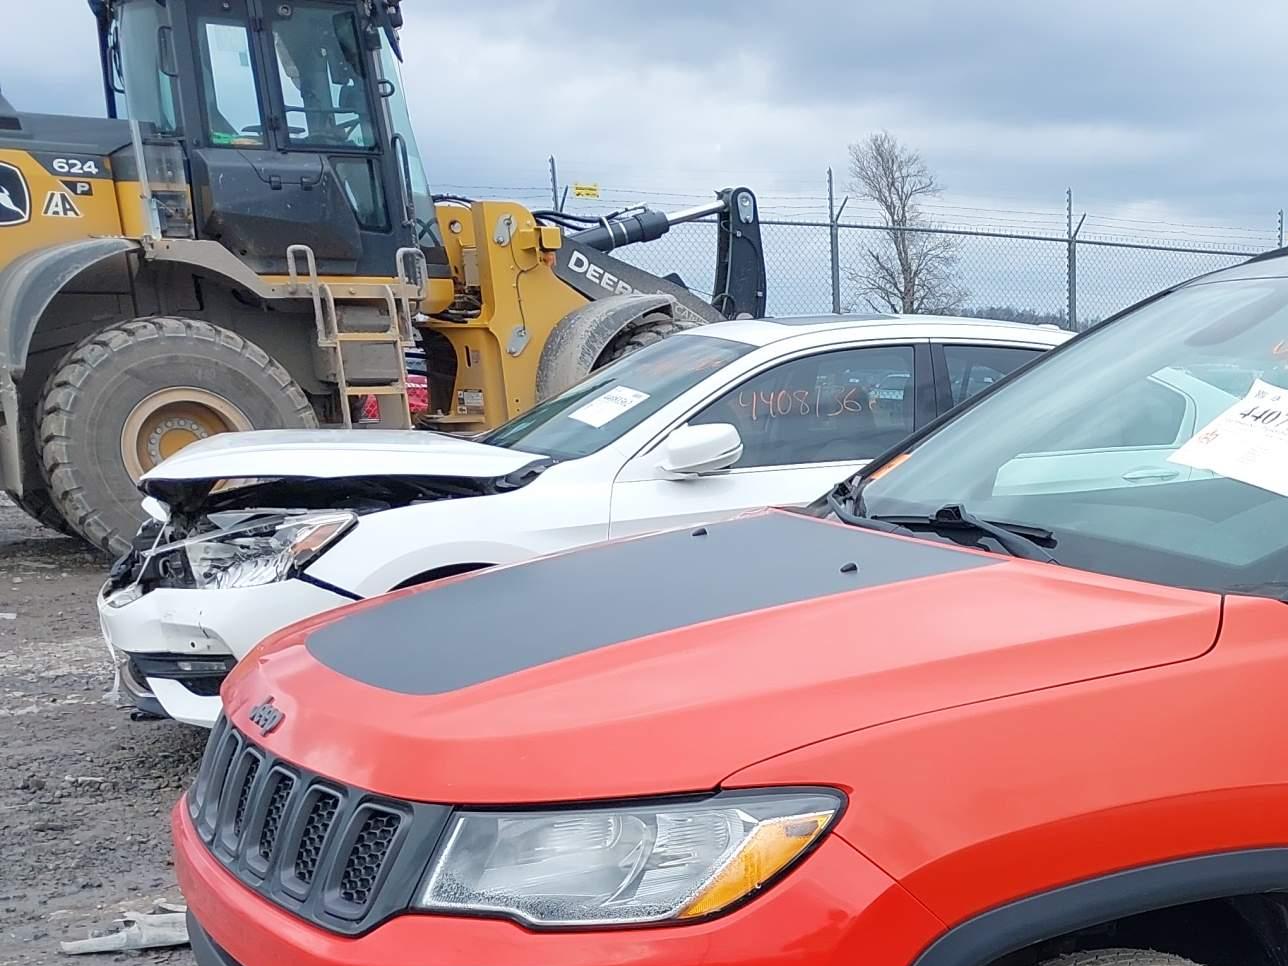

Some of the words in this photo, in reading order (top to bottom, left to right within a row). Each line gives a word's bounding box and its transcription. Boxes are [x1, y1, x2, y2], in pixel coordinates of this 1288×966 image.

[52, 158, 99, 175] 624
[76, 182, 90, 195] P
[567, 250, 647, 296] DEER
